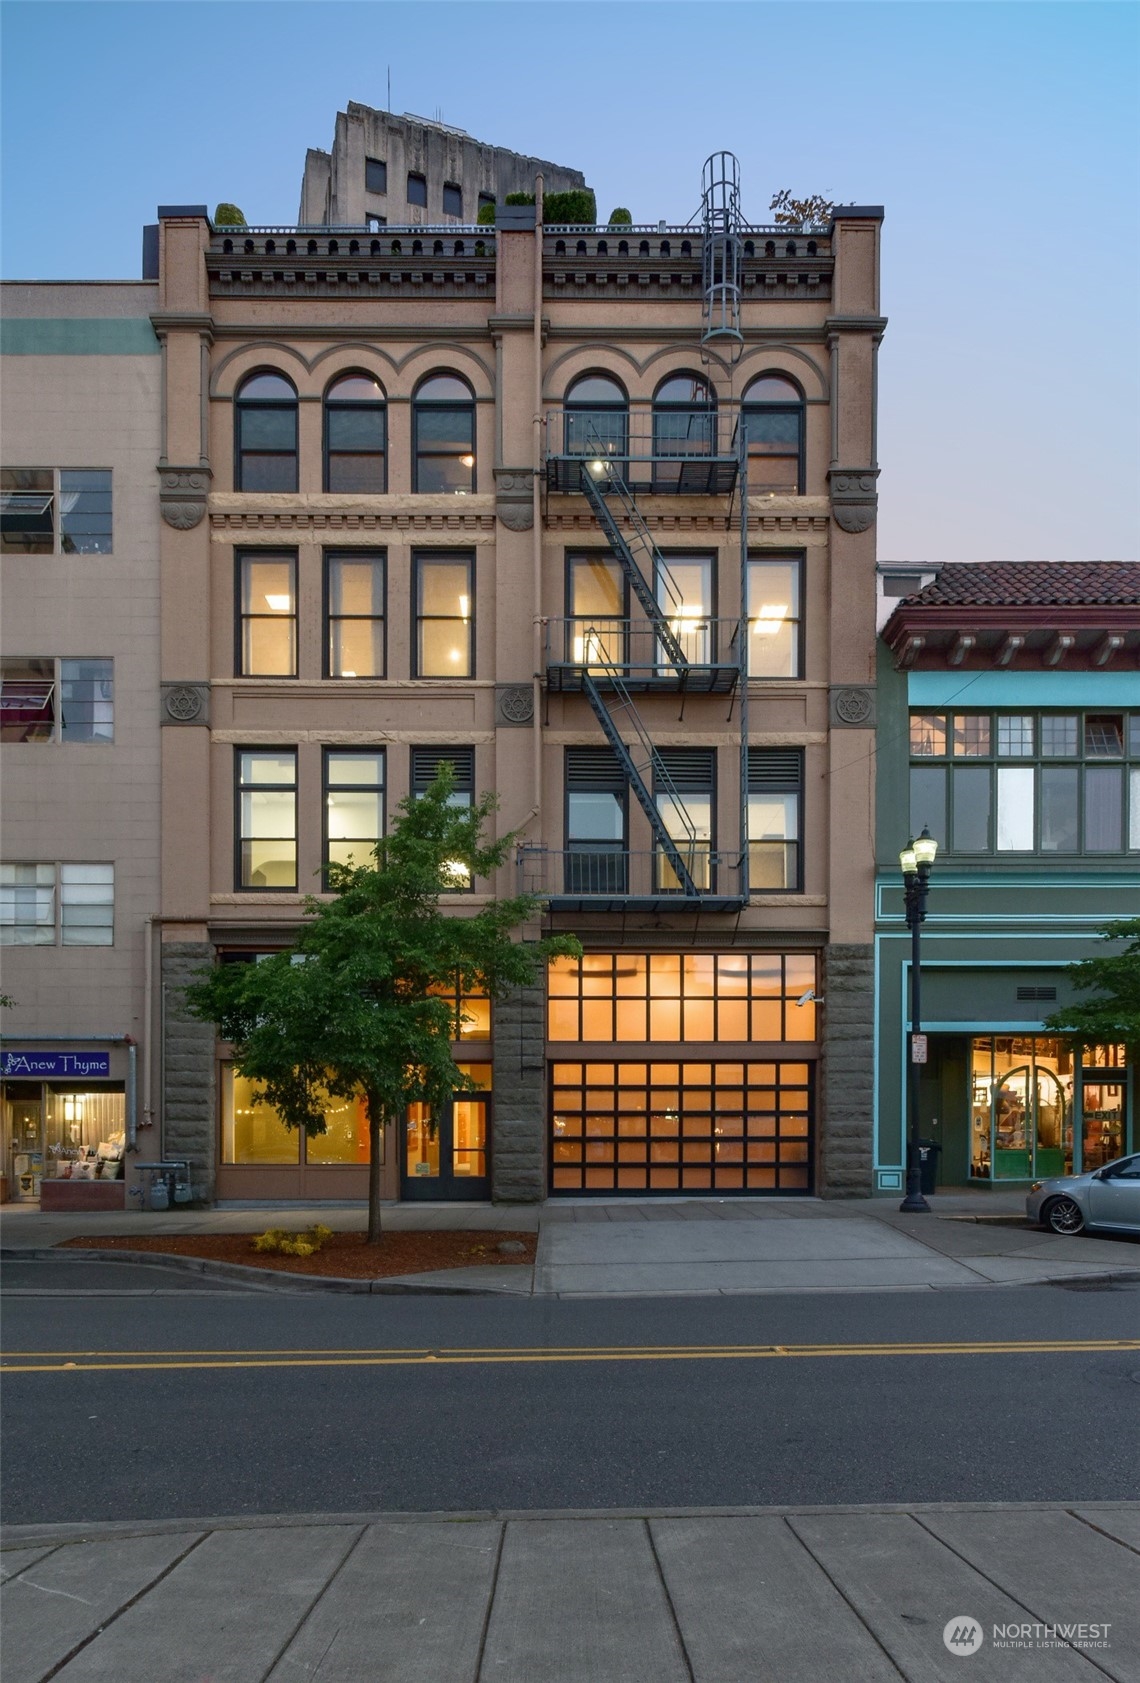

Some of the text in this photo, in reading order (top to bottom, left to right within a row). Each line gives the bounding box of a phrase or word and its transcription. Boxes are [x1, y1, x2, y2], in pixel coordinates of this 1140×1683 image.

[15, 1055, 108, 1075] Anew Thyme
[1095, 1111, 1117, 1120] EXIT
